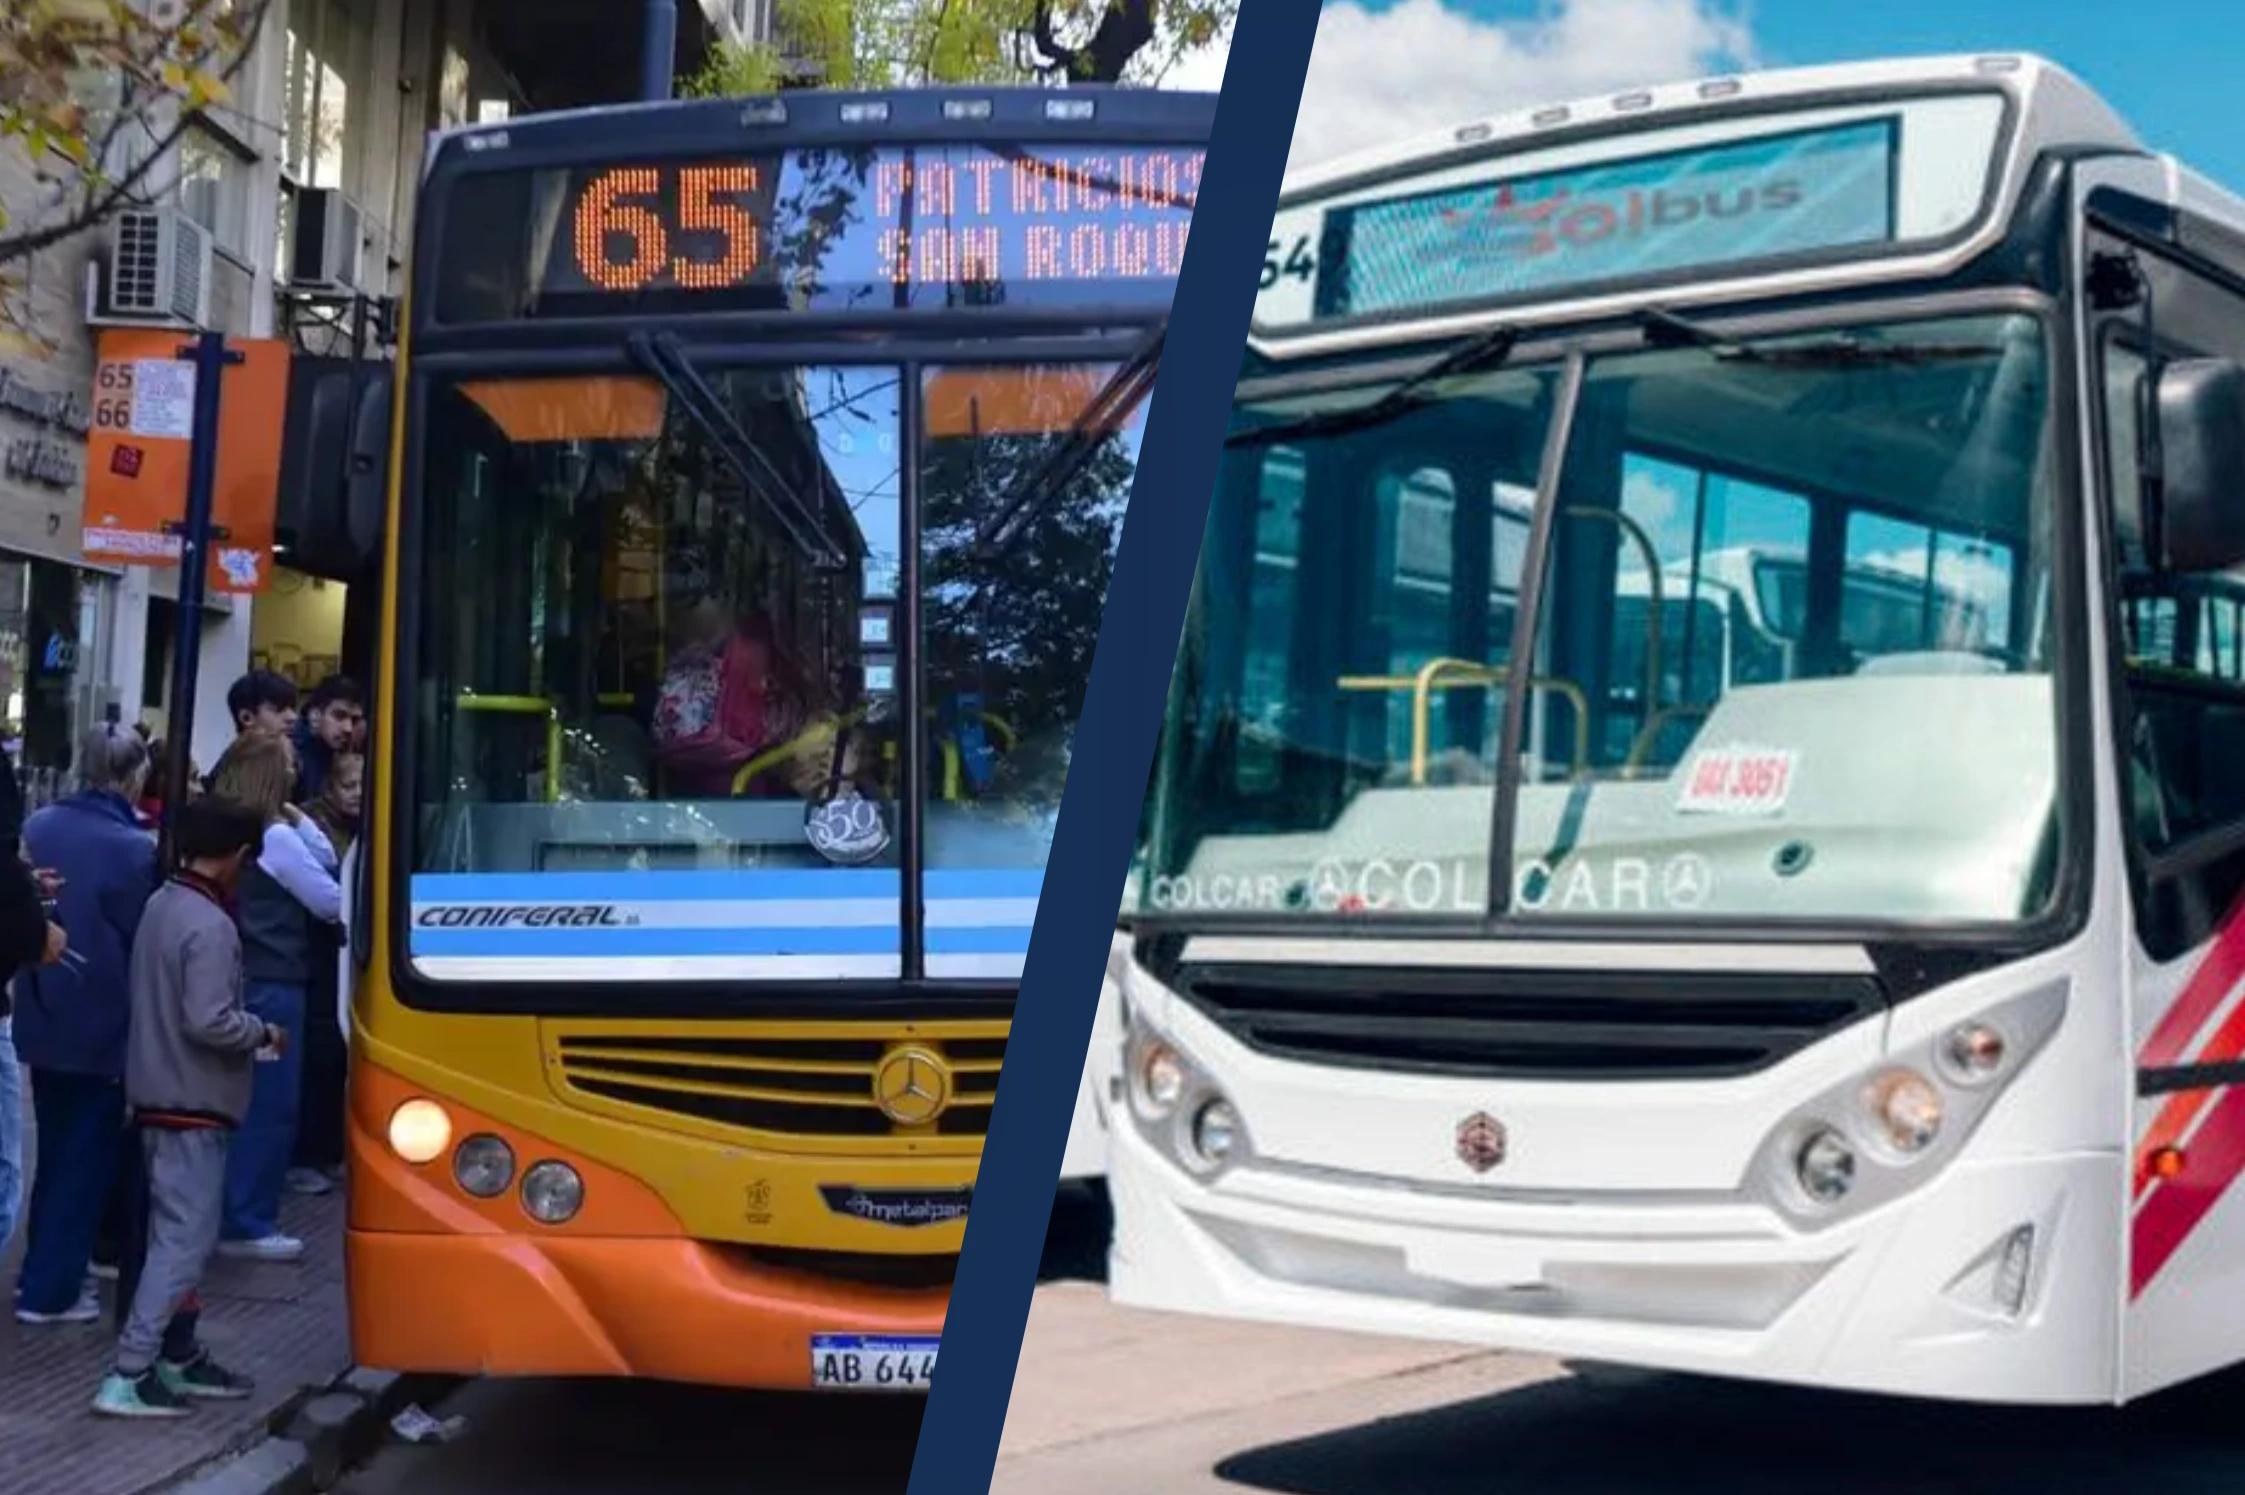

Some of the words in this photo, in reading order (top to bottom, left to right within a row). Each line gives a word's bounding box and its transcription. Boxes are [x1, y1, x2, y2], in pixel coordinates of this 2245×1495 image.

[573, 165, 759, 290] 65
[1024, 221, 1192, 280] ROQU
[99, 363, 133, 390] 65
[96, 398, 131, 429] 66
[1152, 873, 1280, 909] COLCAR
[418, 905, 621, 928] CONIFERAL
[822, 1352, 863, 1384] AB
[875, 1353, 935, 1384] 644
